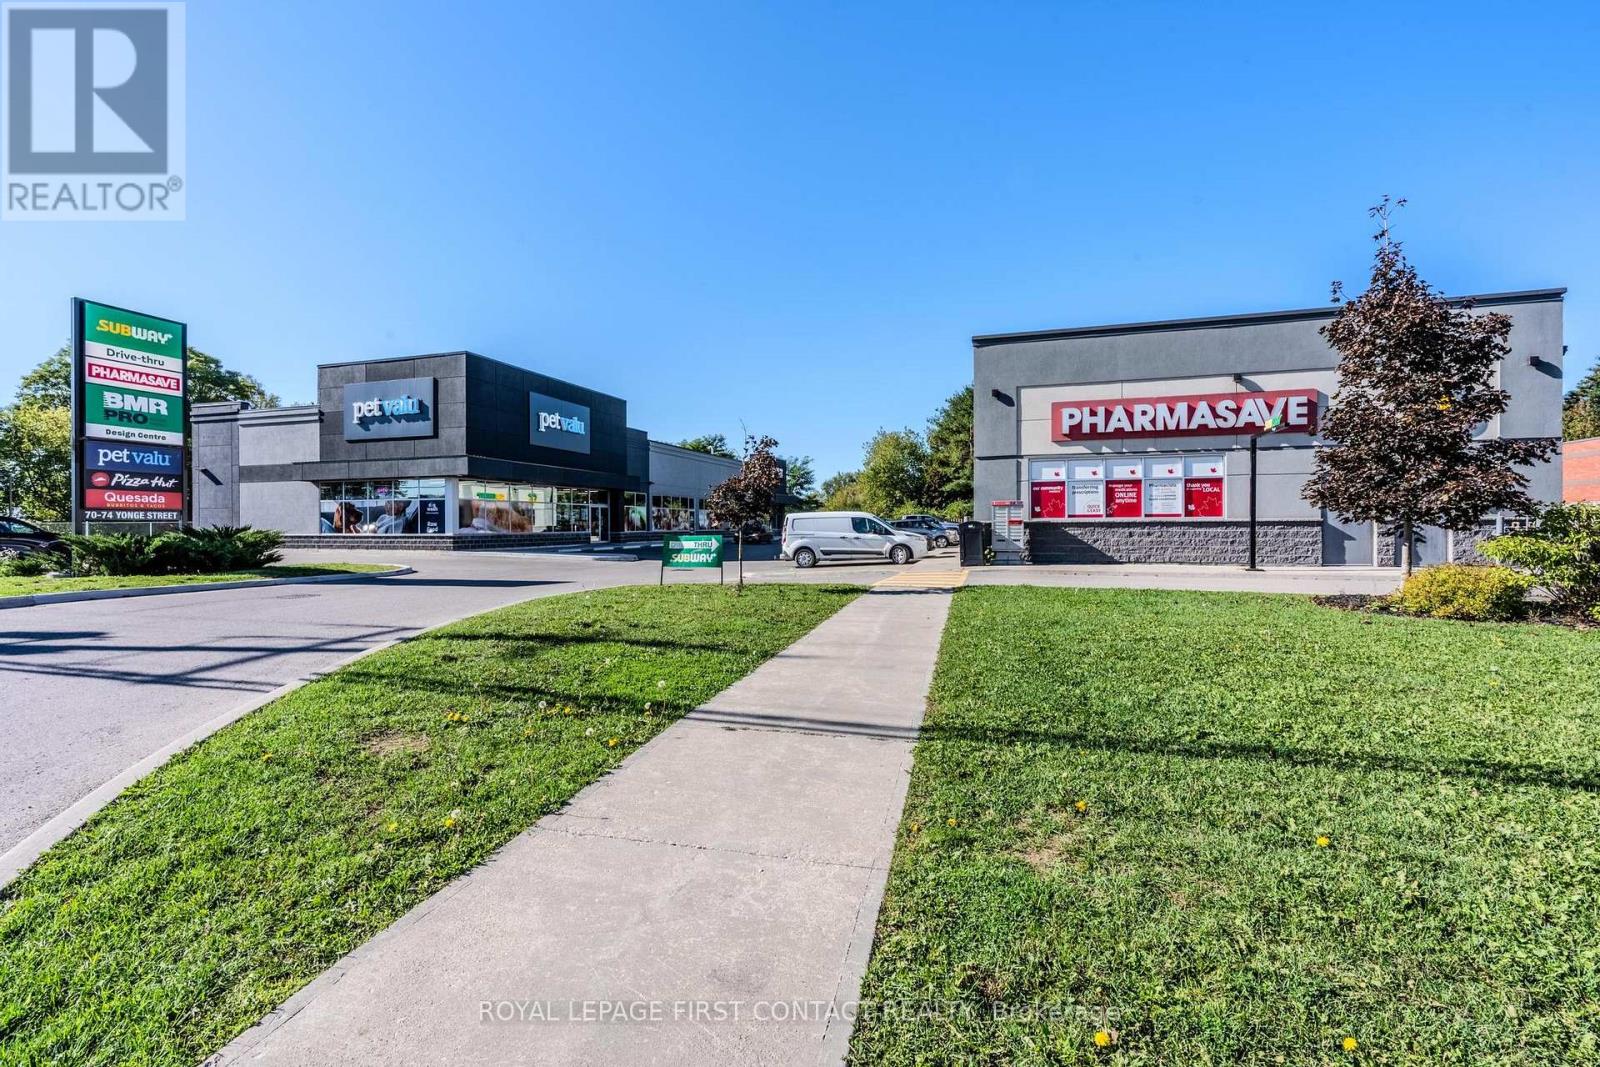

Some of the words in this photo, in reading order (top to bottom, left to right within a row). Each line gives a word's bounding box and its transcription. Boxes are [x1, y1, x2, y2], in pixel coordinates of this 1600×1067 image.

[96, 320, 173, 345] SUBWAY
[106, 348, 165, 366] Drive-thru
[91, 365, 178, 389] PHARMASAVE
[103, 391, 168, 416] BMR
[352, 397, 383, 424] pet
[382, 393, 421, 417] valu
[104, 409, 148, 424] PRO
[538, 411, 561, 432] pet
[560, 416, 586, 435] valu
[1060, 395, 1309, 435] PHARMASAVE
[105, 429, 136, 439] Design
[137, 432, 167, 441] Centre
[97, 448, 130, 466] pet
[131, 450, 171, 466] valu
[111, 473, 150, 487] Pizza
[150, 476, 178, 488] Hut
[105, 492, 166, 503] Quesada
[85, 511, 113, 519] 70-74
[115, 511, 145, 519] YONGE
[146, 511, 178, 519] STREET
[670, 552, 717, 563] SUBWAY
